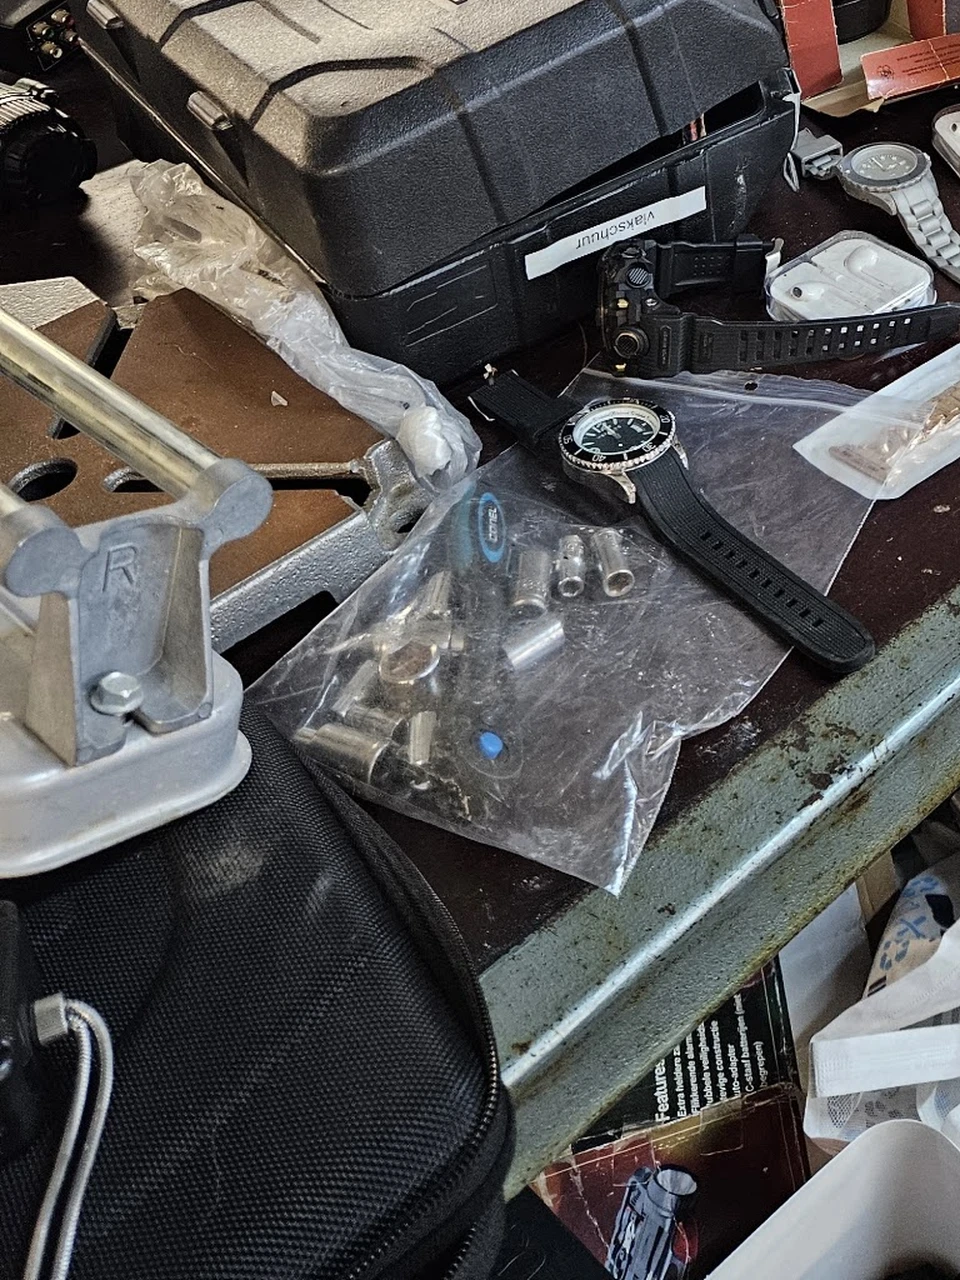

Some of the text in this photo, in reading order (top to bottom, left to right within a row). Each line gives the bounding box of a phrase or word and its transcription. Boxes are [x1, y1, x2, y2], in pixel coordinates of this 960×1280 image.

[575, 210, 655, 250] vlakschuur
[102, 542, 138, 592] R
[711, 1020, 725, 1071] constructie
[737, 1015, 750, 1058] batterijen
[673, 1056, 685, 1092] heldere
[687, 1059, 700, 1116] Flikkerende
[702, 1072, 714, 1107] ubbele
[727, 1043, 741, 1097] uto-adapter
[741, 1058, 755, 1093] C-staaf
[677, 1093, 687, 1117] Extra
